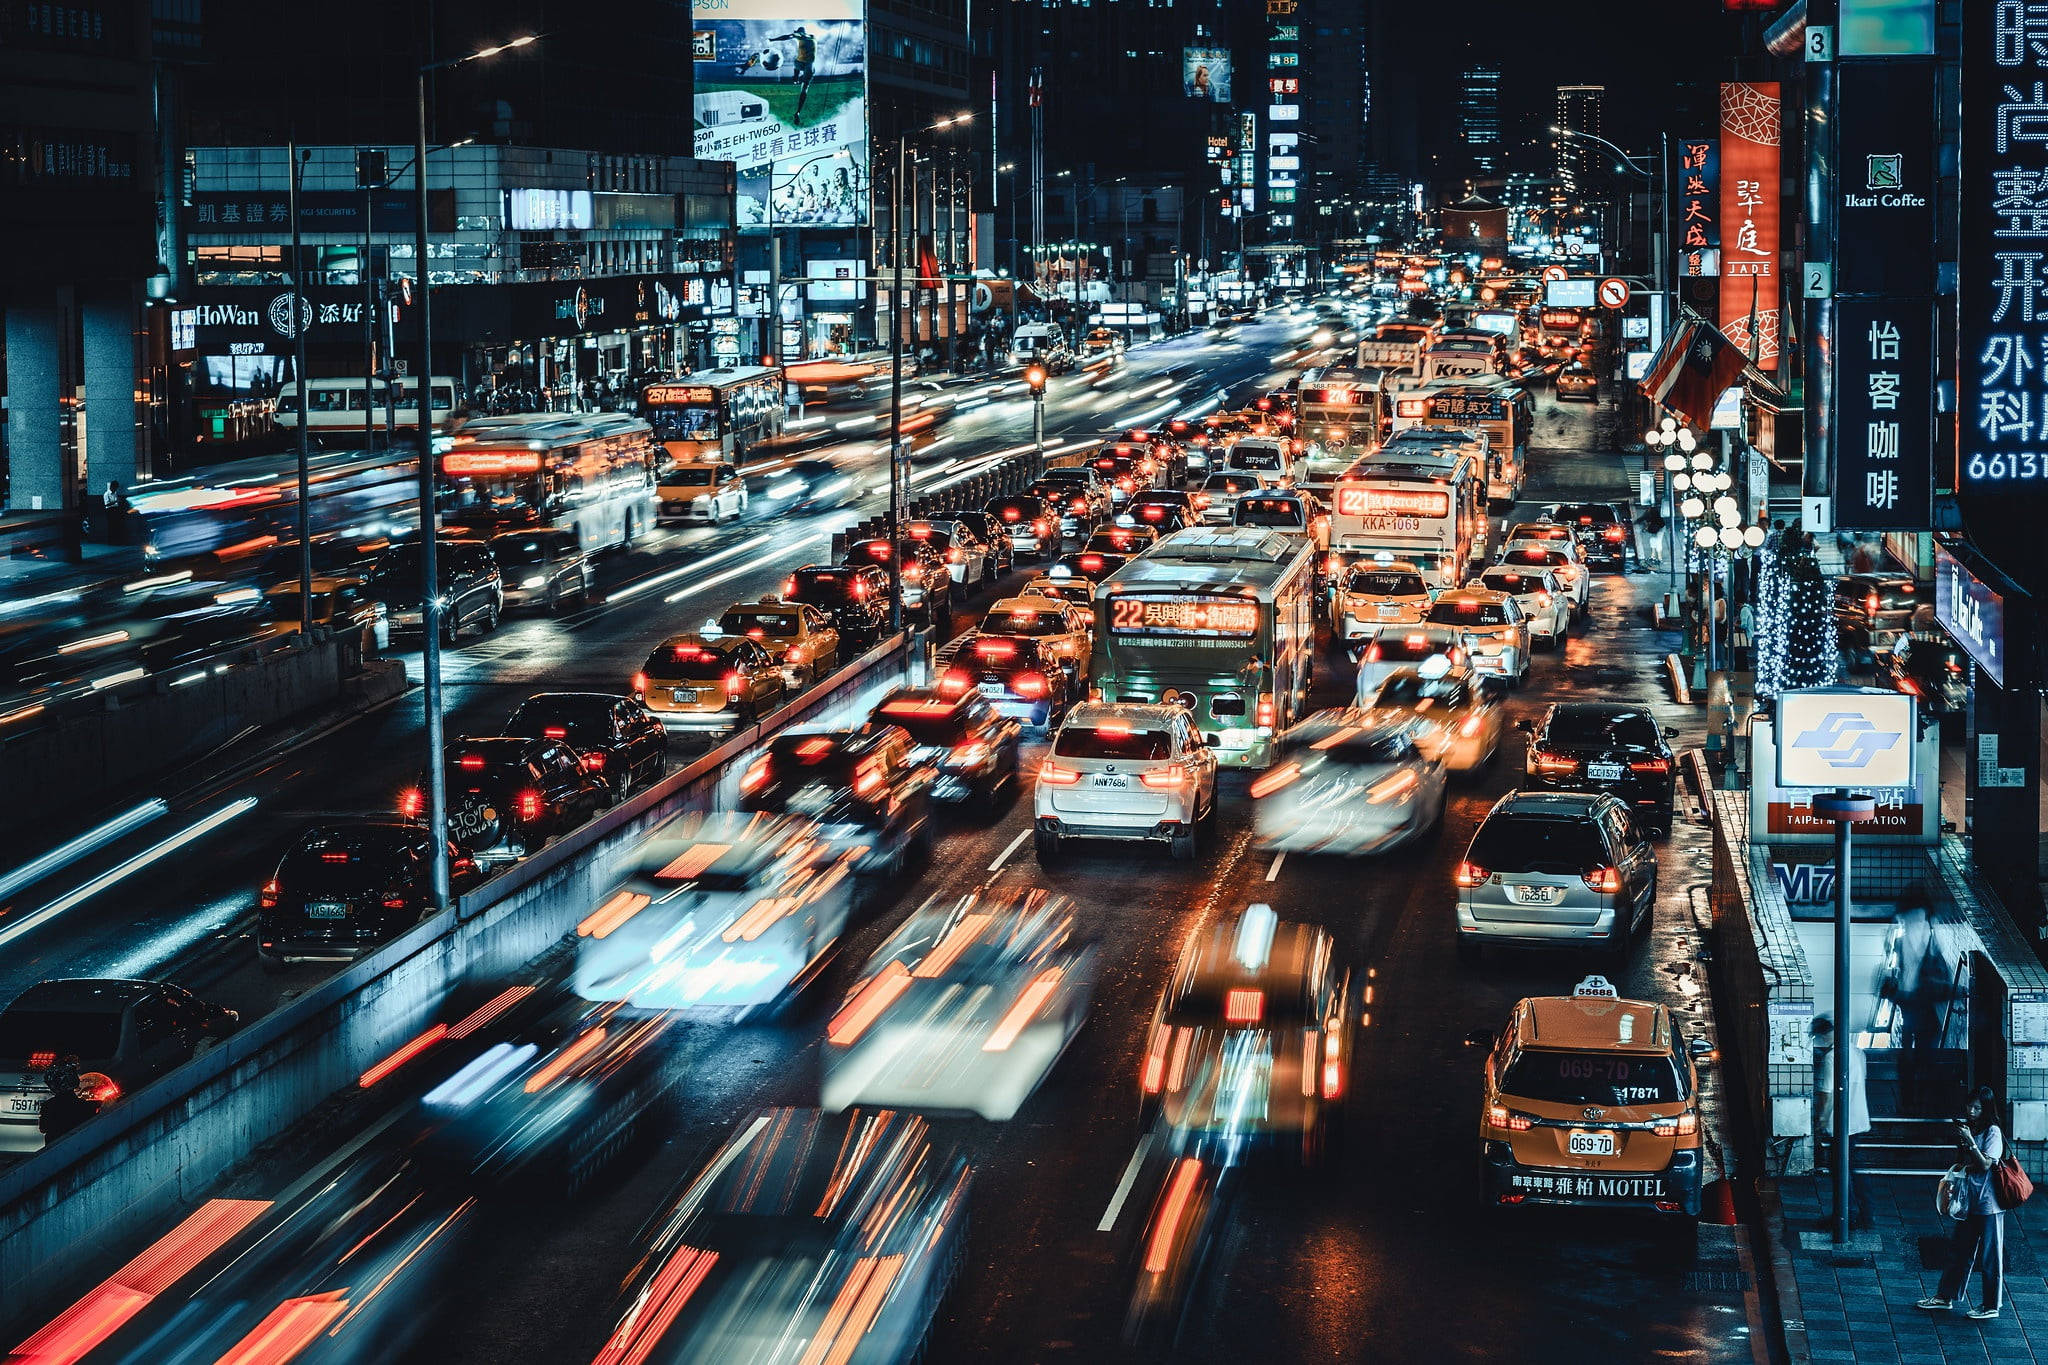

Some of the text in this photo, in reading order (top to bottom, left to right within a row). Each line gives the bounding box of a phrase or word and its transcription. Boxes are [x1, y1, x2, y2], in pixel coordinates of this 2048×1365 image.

[1811, 33, 1824, 53] 3
[1208, 137, 1228, 146] Hotel
[1845, 194, 1926, 208] Ikari Coffee
[198, 204, 288, 223] 凱基證券
[1729, 264, 1770, 274] JADE
[1810, 272, 1823, 290] 2
[1866, 320, 1900, 509] 怡客咖啡
[1344, 492, 1369, 510] 221
[1814, 504, 1822, 523] 1
[1363, 517, 1420, 530] KKA-1069
[1114, 600, 1143, 628] 22
[1578, 987, 1613, 996] 55688
[1571, 1137, 1613, 1152] 069-7D
[1555, 1177, 1594, 1196] 雅柏
[1598, 1179, 1666, 1197] MOTEL
